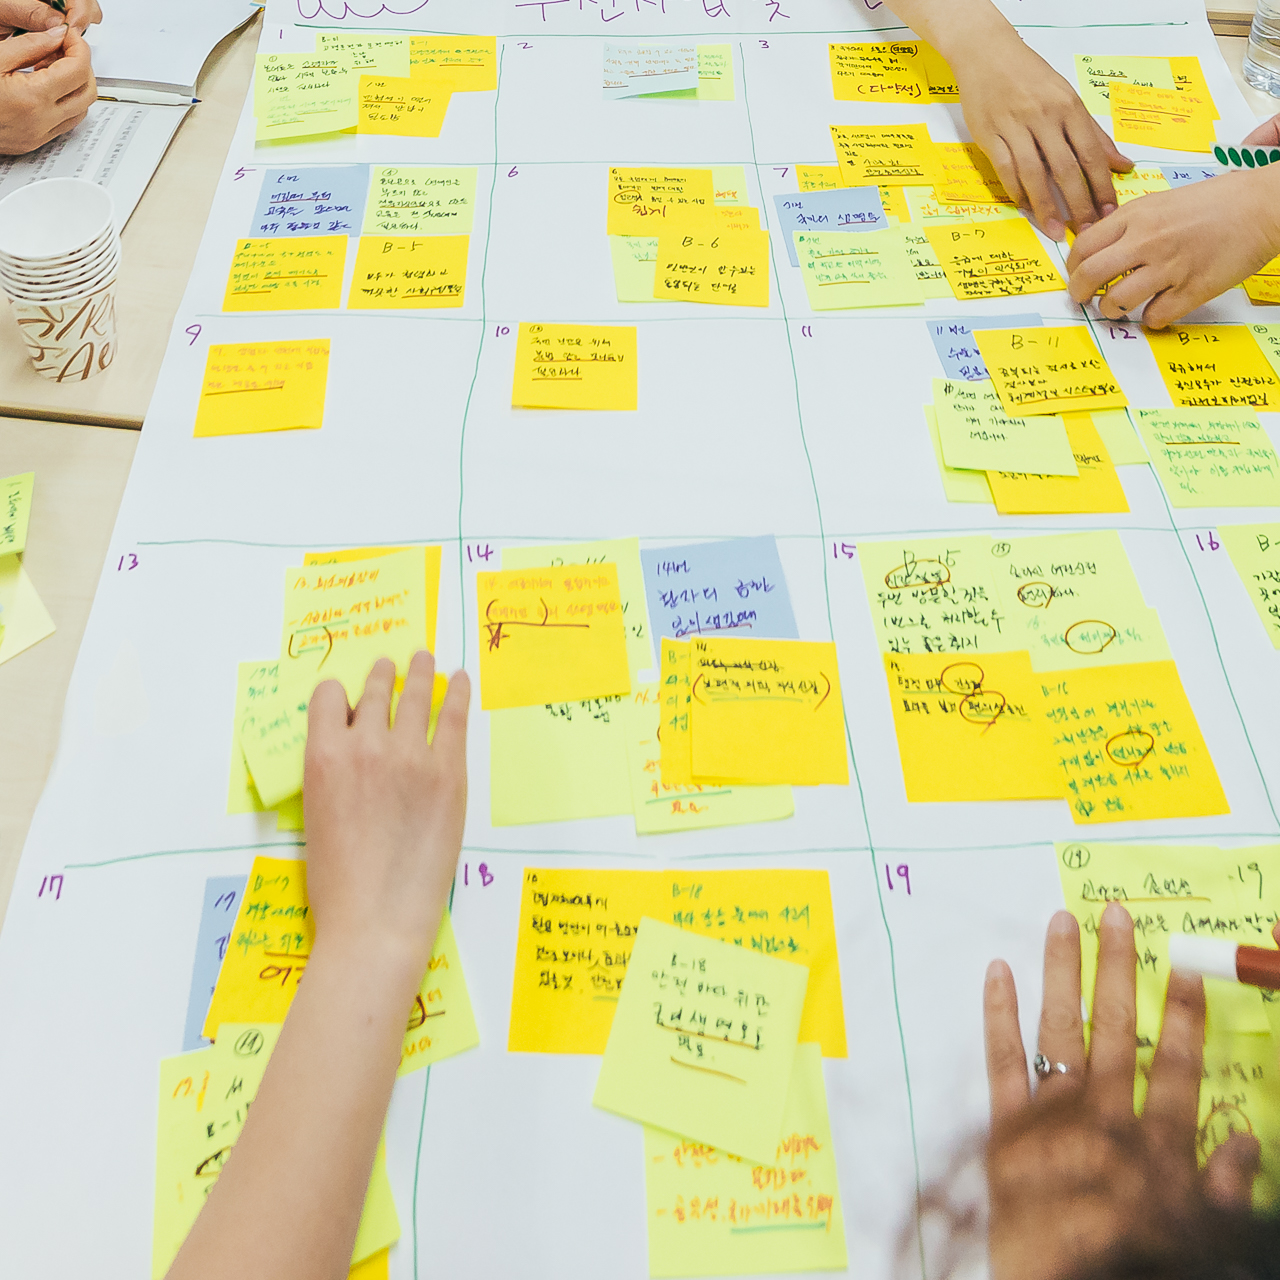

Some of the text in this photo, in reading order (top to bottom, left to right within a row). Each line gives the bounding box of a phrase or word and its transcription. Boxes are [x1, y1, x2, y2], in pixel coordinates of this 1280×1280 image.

[759, 39, 771, 49] 3
[234, 167, 257, 182] 5
[506, 165, 520, 181] 6
[773, 167, 789, 178] 7
[184, 324, 203, 346] 9
[495, 325, 511, 338] 10
[1110, 327, 1138, 341] 12
[833, 542, 858, 560] 15
[1196, 532, 1220, 553] 16
[117, 553, 140, 572] 13
[467, 544, 494, 563] 14
[463, 862, 495, 889] 18
[884, 862, 912, 896] 19
[38, 874, 64, 901] 17
